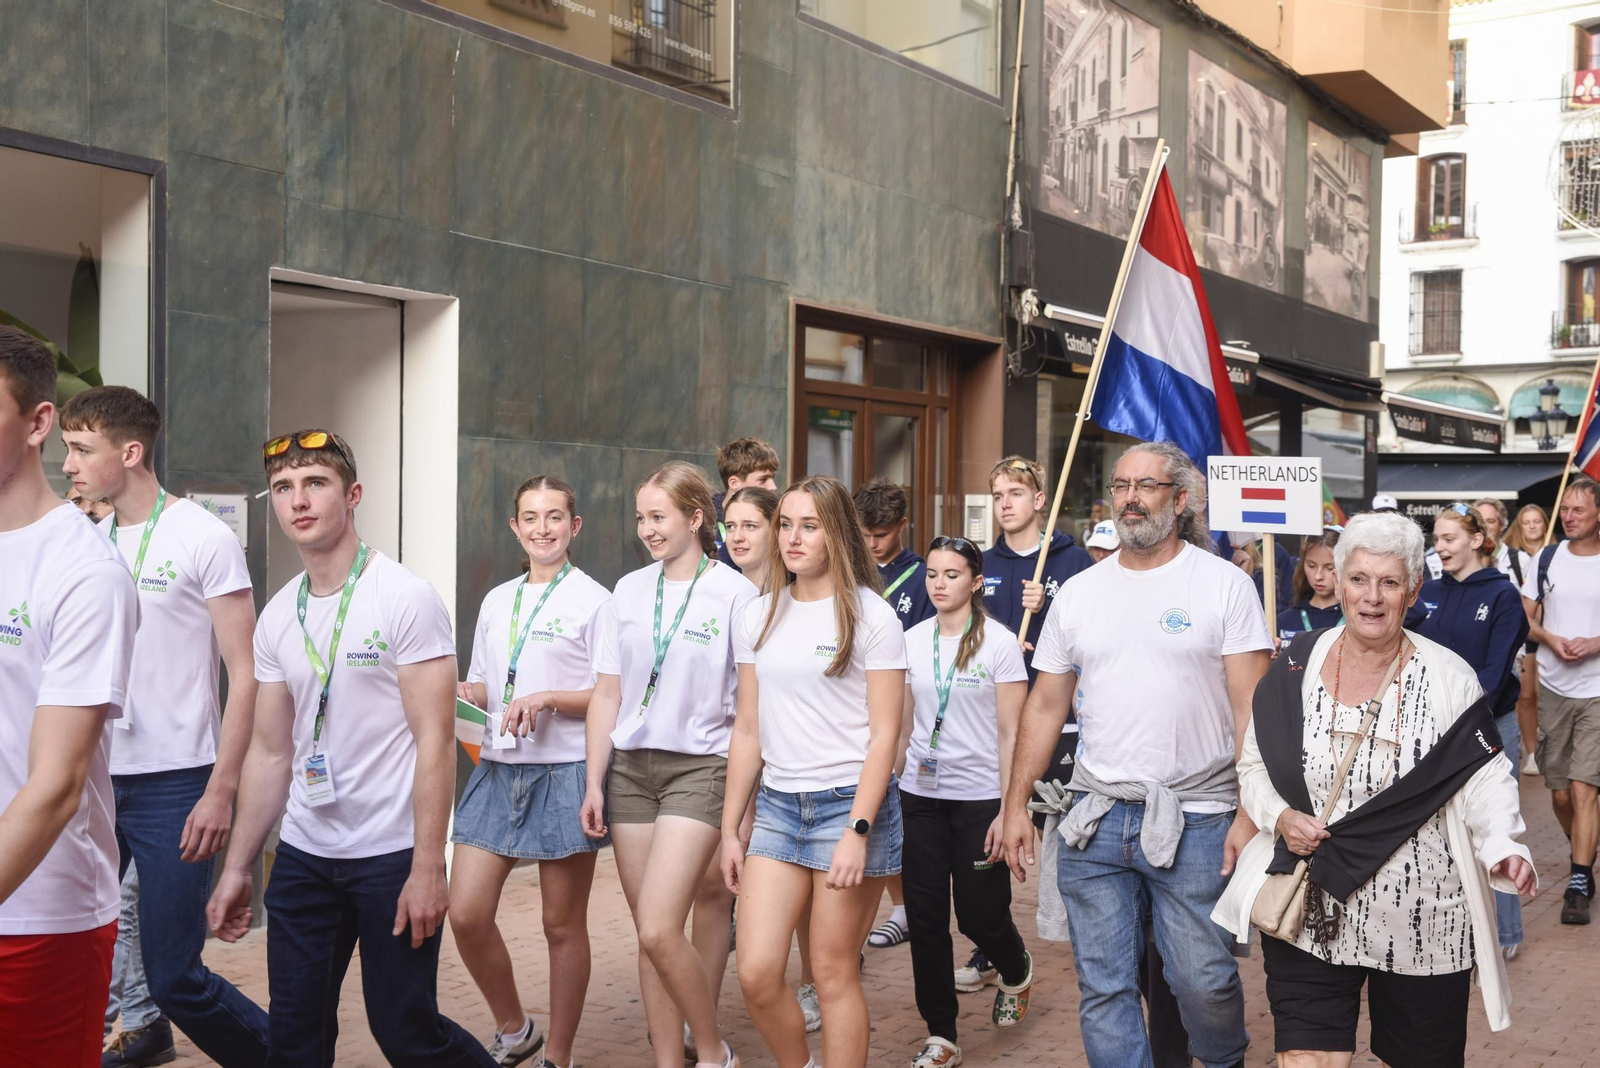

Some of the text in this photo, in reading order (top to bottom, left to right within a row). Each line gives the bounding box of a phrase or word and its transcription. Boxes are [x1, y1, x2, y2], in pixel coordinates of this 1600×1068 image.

[608, 14, 623, 28] 856
[623, 19, 638, 34] 580
[664, 36, 712, 62] www.vitagora.es
[1064, 332, 1093, 356] Estrella
[1210, 464, 1318, 483] NETHERLANDS
[141, 577, 168, 587] ROWING
[140, 584, 167, 593] IRELAND
[531, 635, 554, 643] IRELAND
[532, 630, 555, 638] ROWING
[684, 629, 711, 640] ROWING
[683, 634, 710, 646] IRELAND
[346, 652, 379, 660] ROWING
[815, 650, 838, 659] IRELAN
[346, 659, 379, 667] IRELAND
